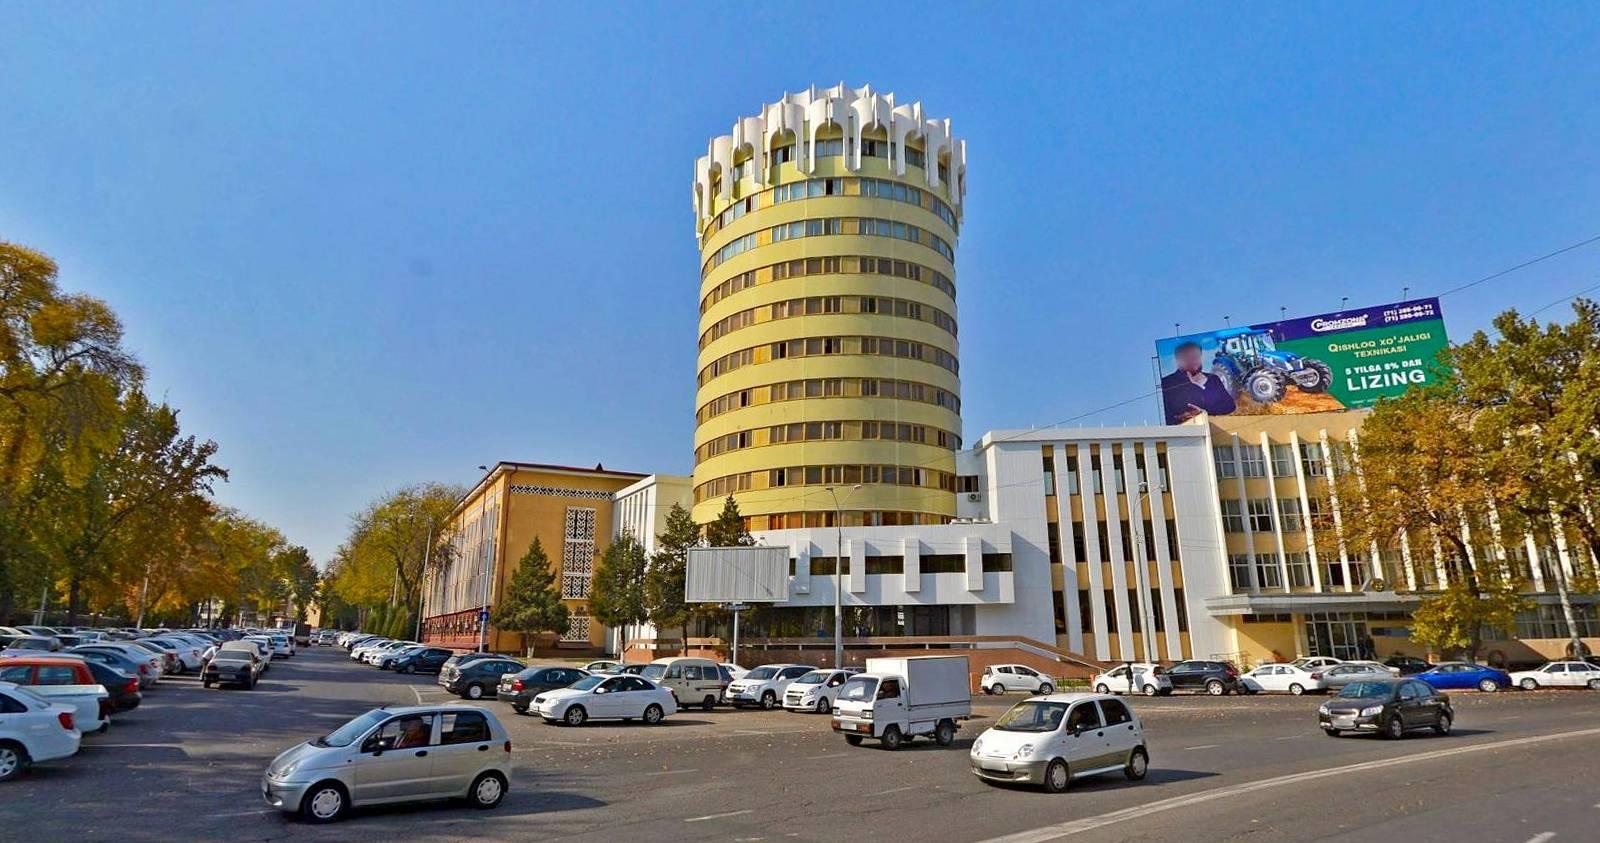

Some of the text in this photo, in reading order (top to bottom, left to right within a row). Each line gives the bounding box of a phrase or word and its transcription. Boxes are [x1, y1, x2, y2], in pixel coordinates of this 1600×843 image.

[1354, 345, 1406, 358] TEXNIKASI
[1354, 364, 1382, 374] YILGA
[1402, 359, 1422, 368] DAN
[1346, 369, 1426, 391] LIZING
